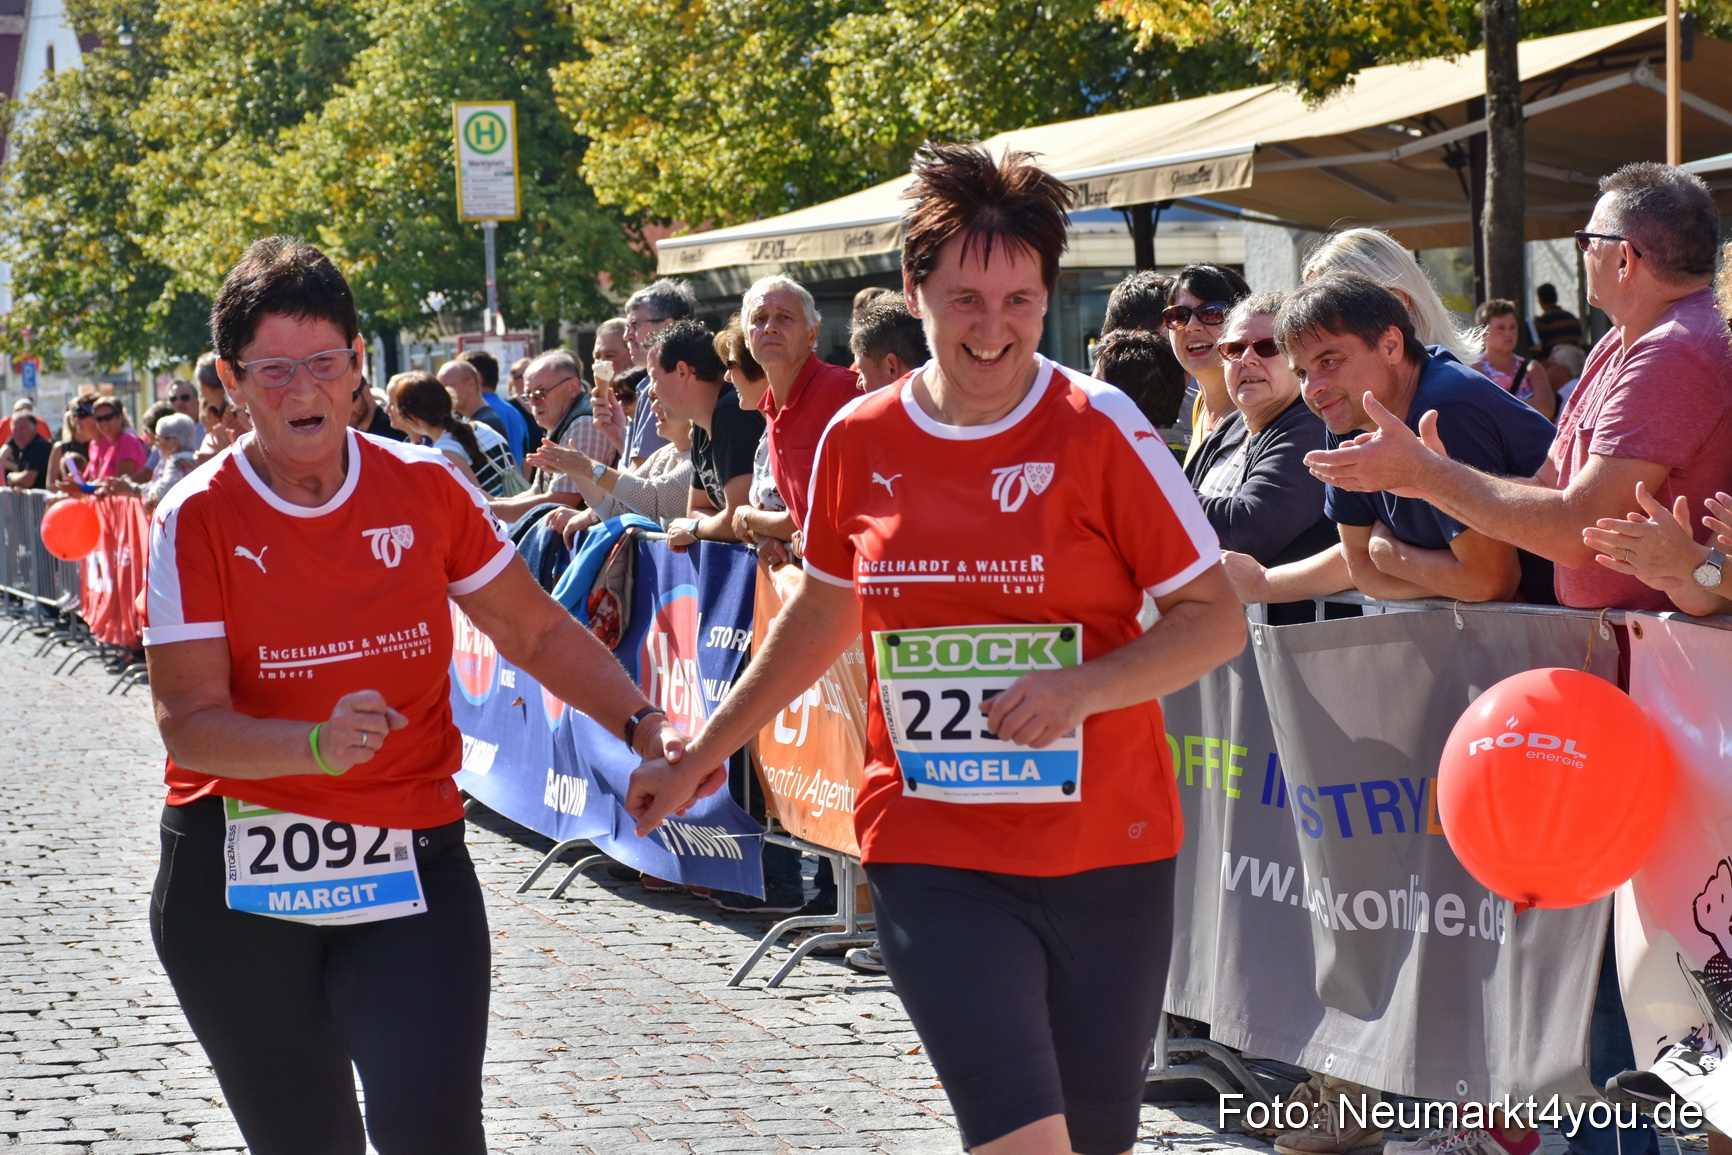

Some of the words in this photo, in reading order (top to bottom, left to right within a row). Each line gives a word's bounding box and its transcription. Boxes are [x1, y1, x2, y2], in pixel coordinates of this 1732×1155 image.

[858, 556, 950, 573] ENGELHARDT
[957, 561, 967, 572] &
[976, 554, 1045, 572] WALTER
[980, 575, 1045, 583] HERRENHAUS
[1003, 584, 1044, 594] Lauf
[258, 640, 355, 661] ENGELHARDT
[362, 638, 370, 648] &
[376, 621, 430, 645] WALTER
[364, 648, 380, 657] DAS
[382, 638, 431, 654] HERRENHAUS
[893, 633, 1061, 672] BOCK
[258, 669, 314, 679] Amberg
[402, 646, 432, 660] Lauf
[925, 759, 1042, 782] ANGELA
[1526, 751, 1584, 769] energie
[247, 821, 391, 875] 2092
[268, 883, 378, 912] MARGIT
